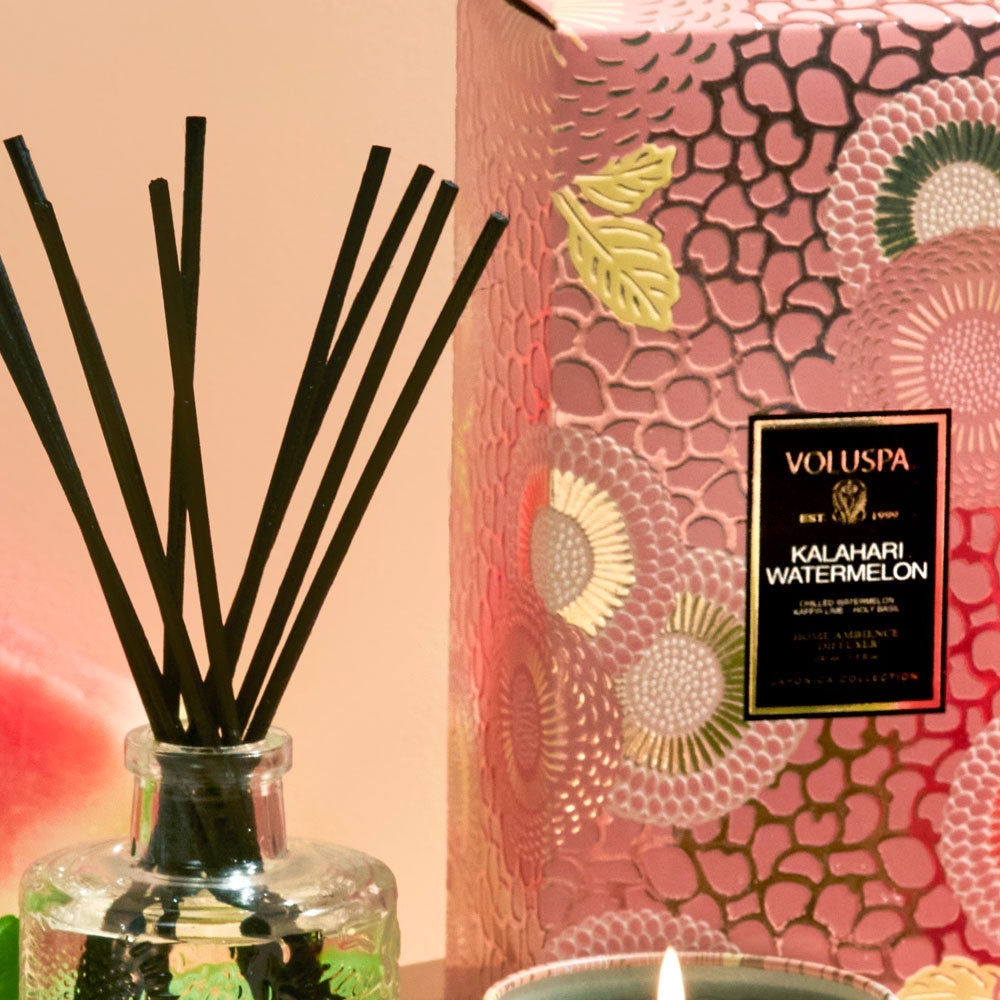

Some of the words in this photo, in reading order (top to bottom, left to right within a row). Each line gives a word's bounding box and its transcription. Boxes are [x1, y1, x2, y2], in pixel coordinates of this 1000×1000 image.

[785, 447, 910, 475] VOLUSPA
[799, 512, 825, 524] EST
[791, 541, 905, 564] KALAHARI
[765, 562, 929, 586] WATERMELON
[836, 596, 895, 606] WATERMELON
[852, 606, 875, 614] HOLY
[839, 672, 920, 684] COLLECTION
